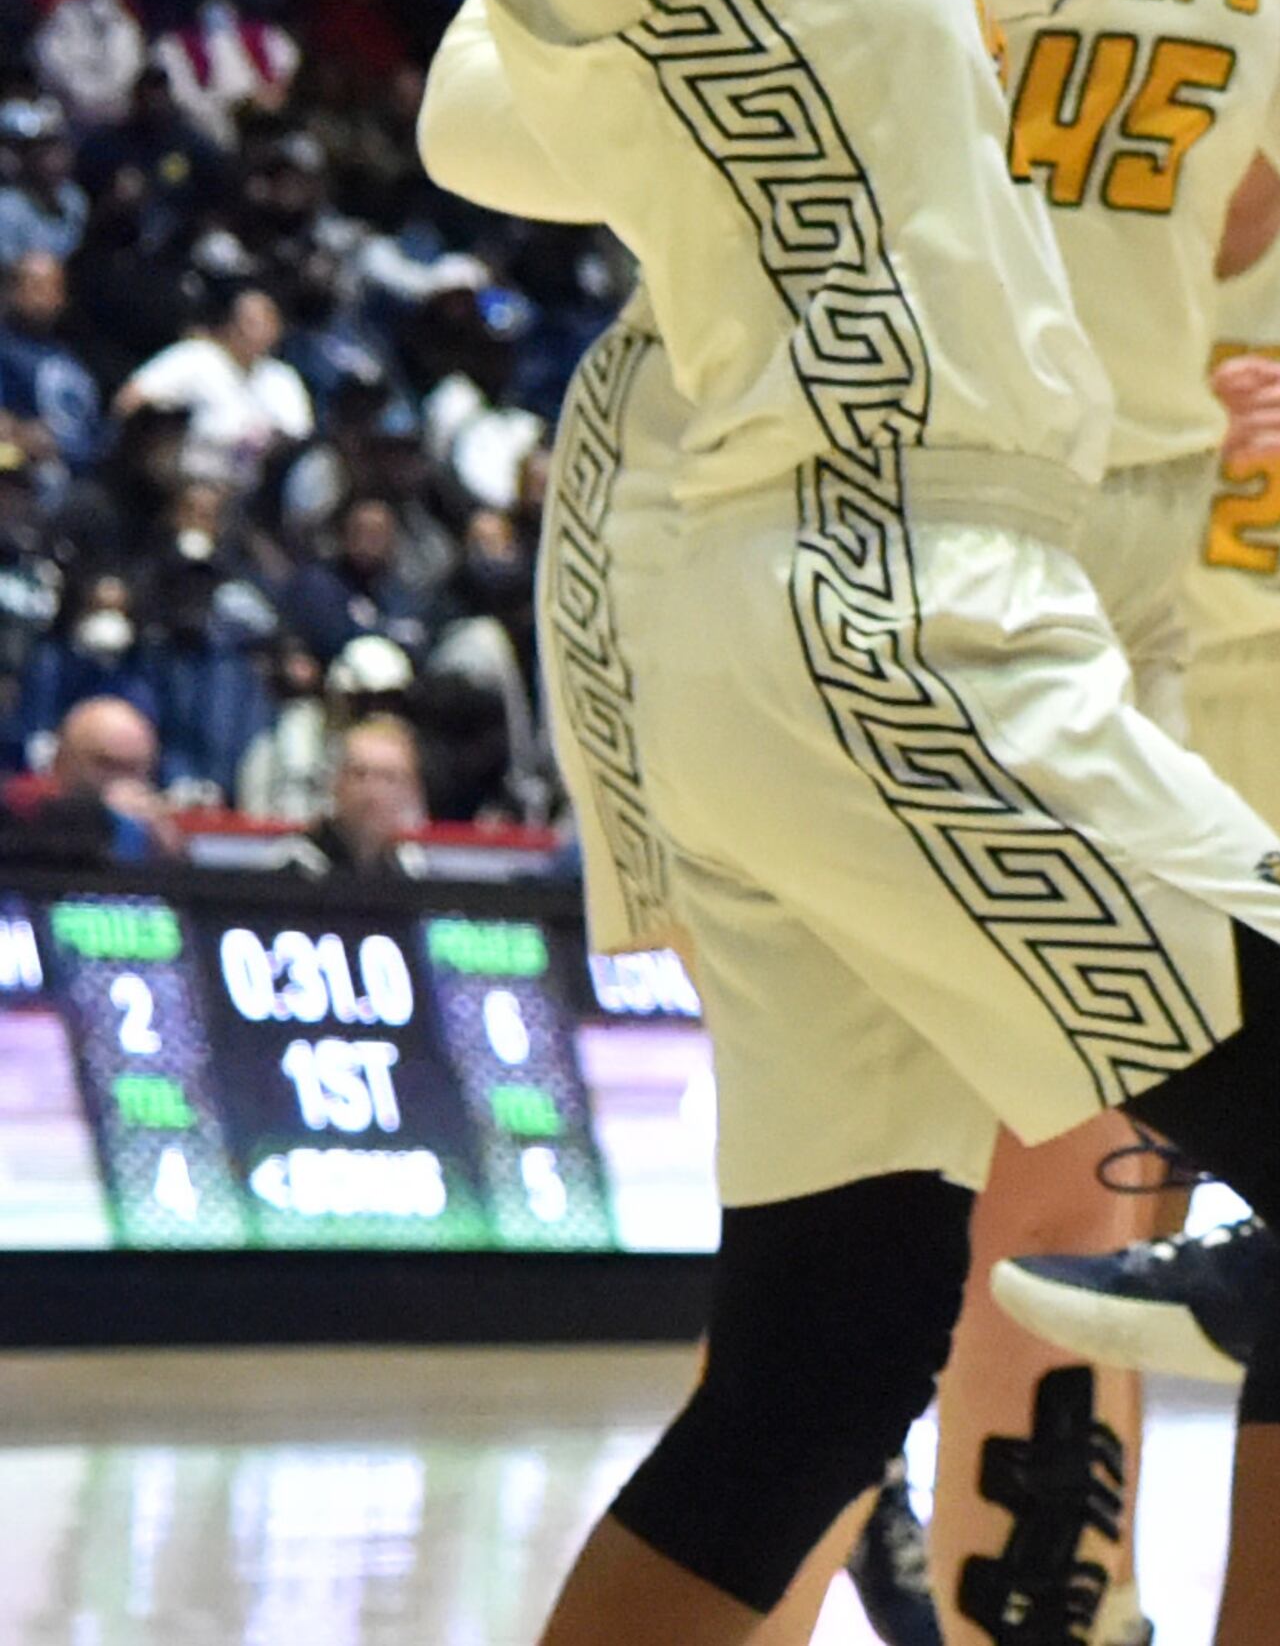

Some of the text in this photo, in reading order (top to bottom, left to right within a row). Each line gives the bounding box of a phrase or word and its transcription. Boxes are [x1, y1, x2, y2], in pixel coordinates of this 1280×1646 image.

[1009, 29, 1236, 216] 45
[110, 972, 162, 1054] 2
[281, 1039, 400, 1133] 1ST
